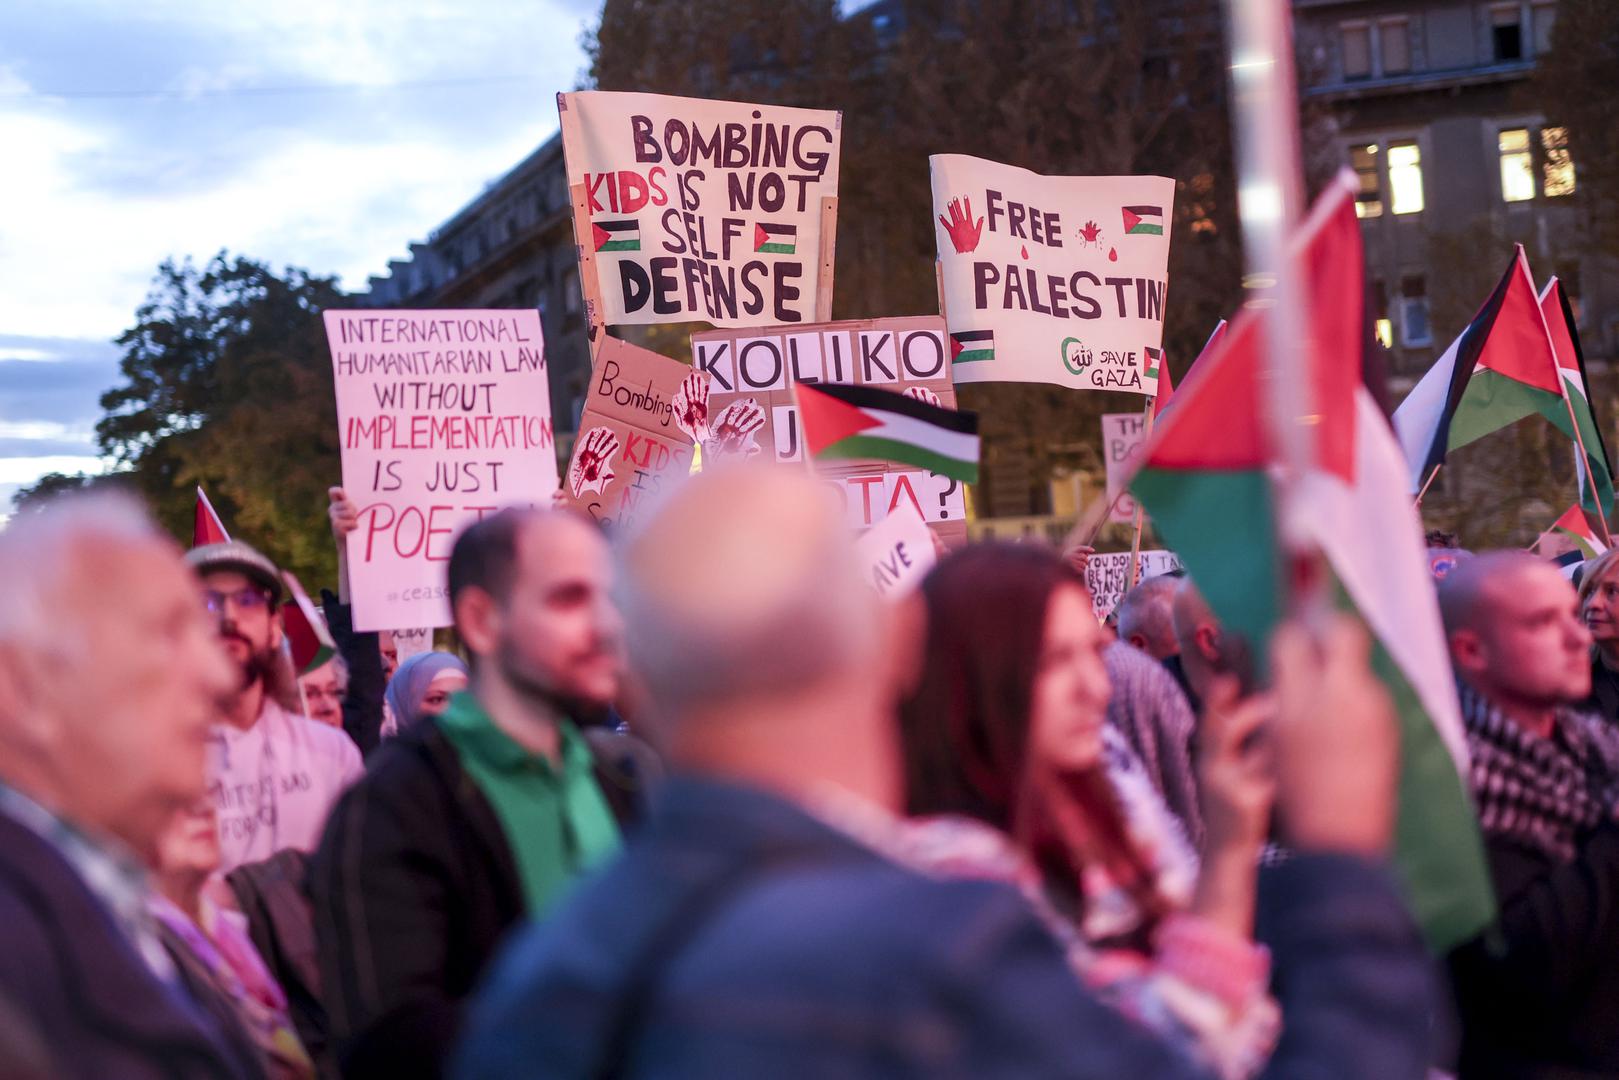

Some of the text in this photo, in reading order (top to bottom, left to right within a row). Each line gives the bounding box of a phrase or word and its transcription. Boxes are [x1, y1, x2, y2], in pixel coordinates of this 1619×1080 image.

[584, 166, 820, 215] KIDS IS NOT
[662, 208, 746, 260] SELF
[986, 189, 1063, 248] FREE
[619, 257, 802, 322] DEFENSE
[974, 261, 1166, 322] PALESTIN
[340, 318, 529, 343] INTERNATIONAL
[338, 346, 546, 375] HUMANITARIAN LAW
[698, 330, 945, 391] KOLIKO
[1091, 369, 1142, 390] GAZA
[1100, 351, 1137, 367] SAVE
[374, 382, 497, 413] WITHOUT
[599, 360, 673, 427] Bombing
[347, 415, 553, 450] IMPLEMENTATION
[373, 460, 504, 492] IS JUST
